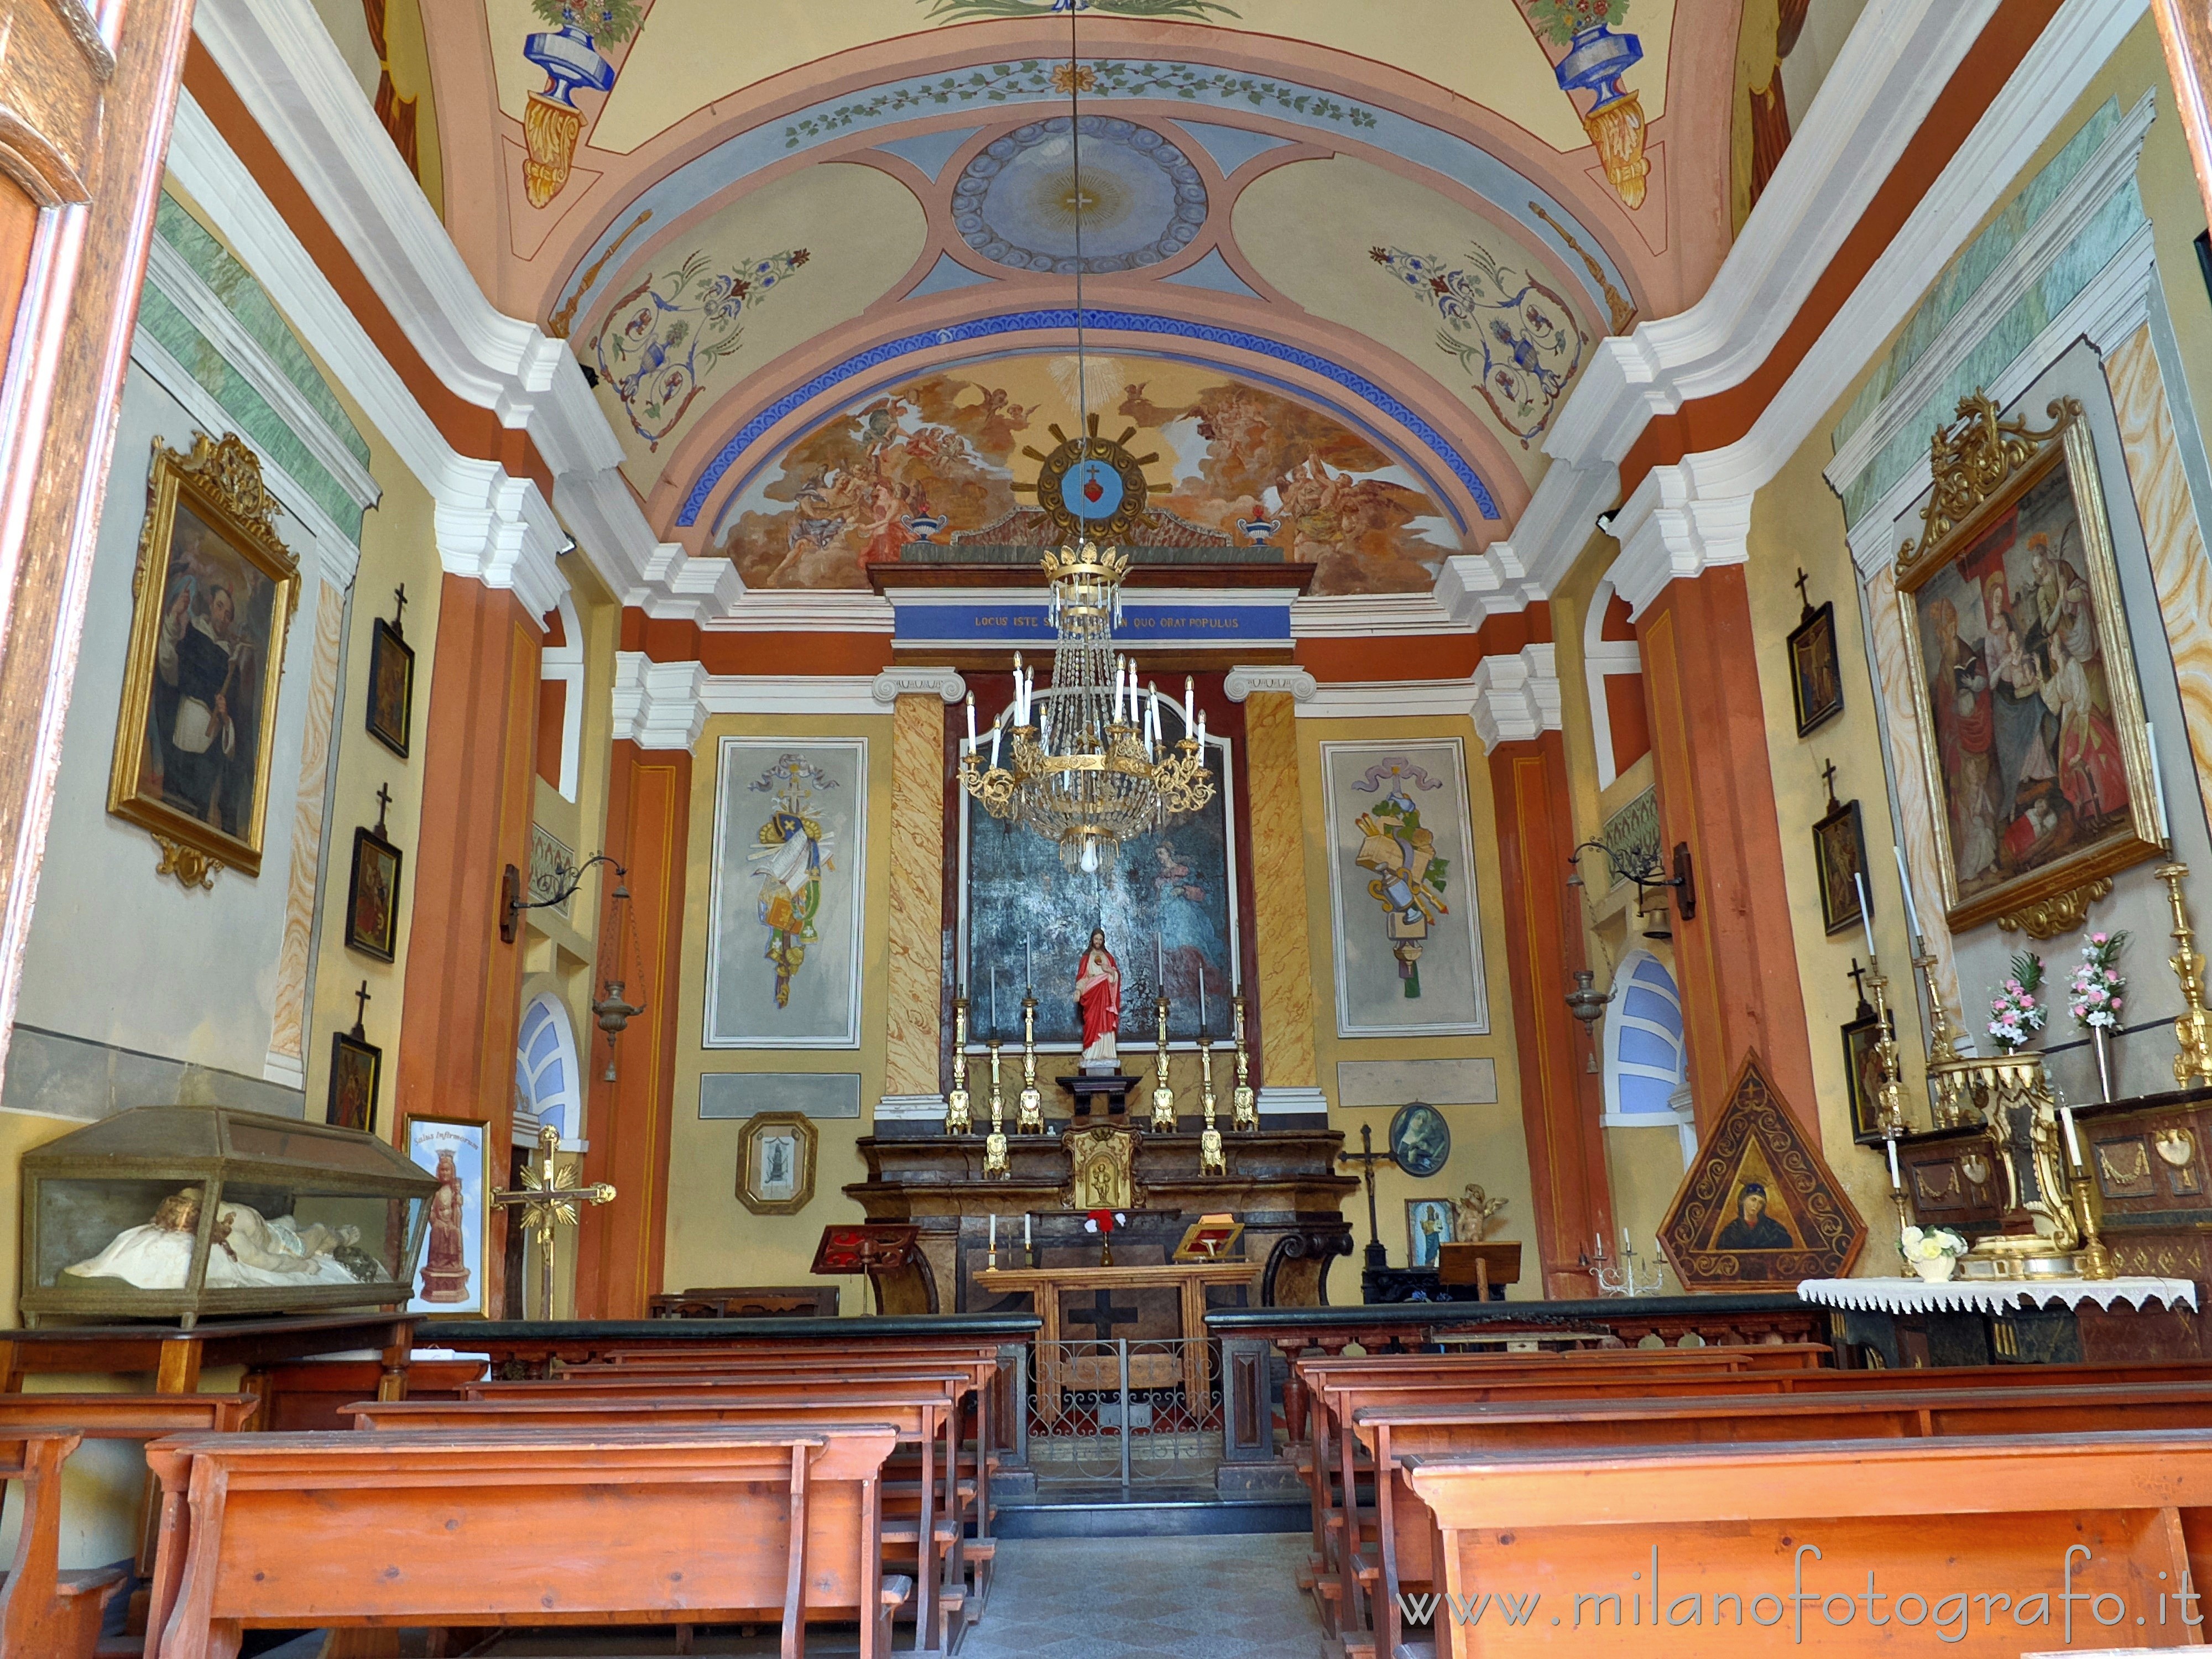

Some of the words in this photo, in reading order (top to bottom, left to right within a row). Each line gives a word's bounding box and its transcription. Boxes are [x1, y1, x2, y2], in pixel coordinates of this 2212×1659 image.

[975, 617, 1008, 627] LOCUS
[1014, 617, 1038, 627] ISTE
[1134, 618, 1155, 629] QUO
[1160, 618, 1186, 628] ORAT
[1190, 618, 1239, 628] POPULUS
[414, 1133, 434, 1146] Salus
